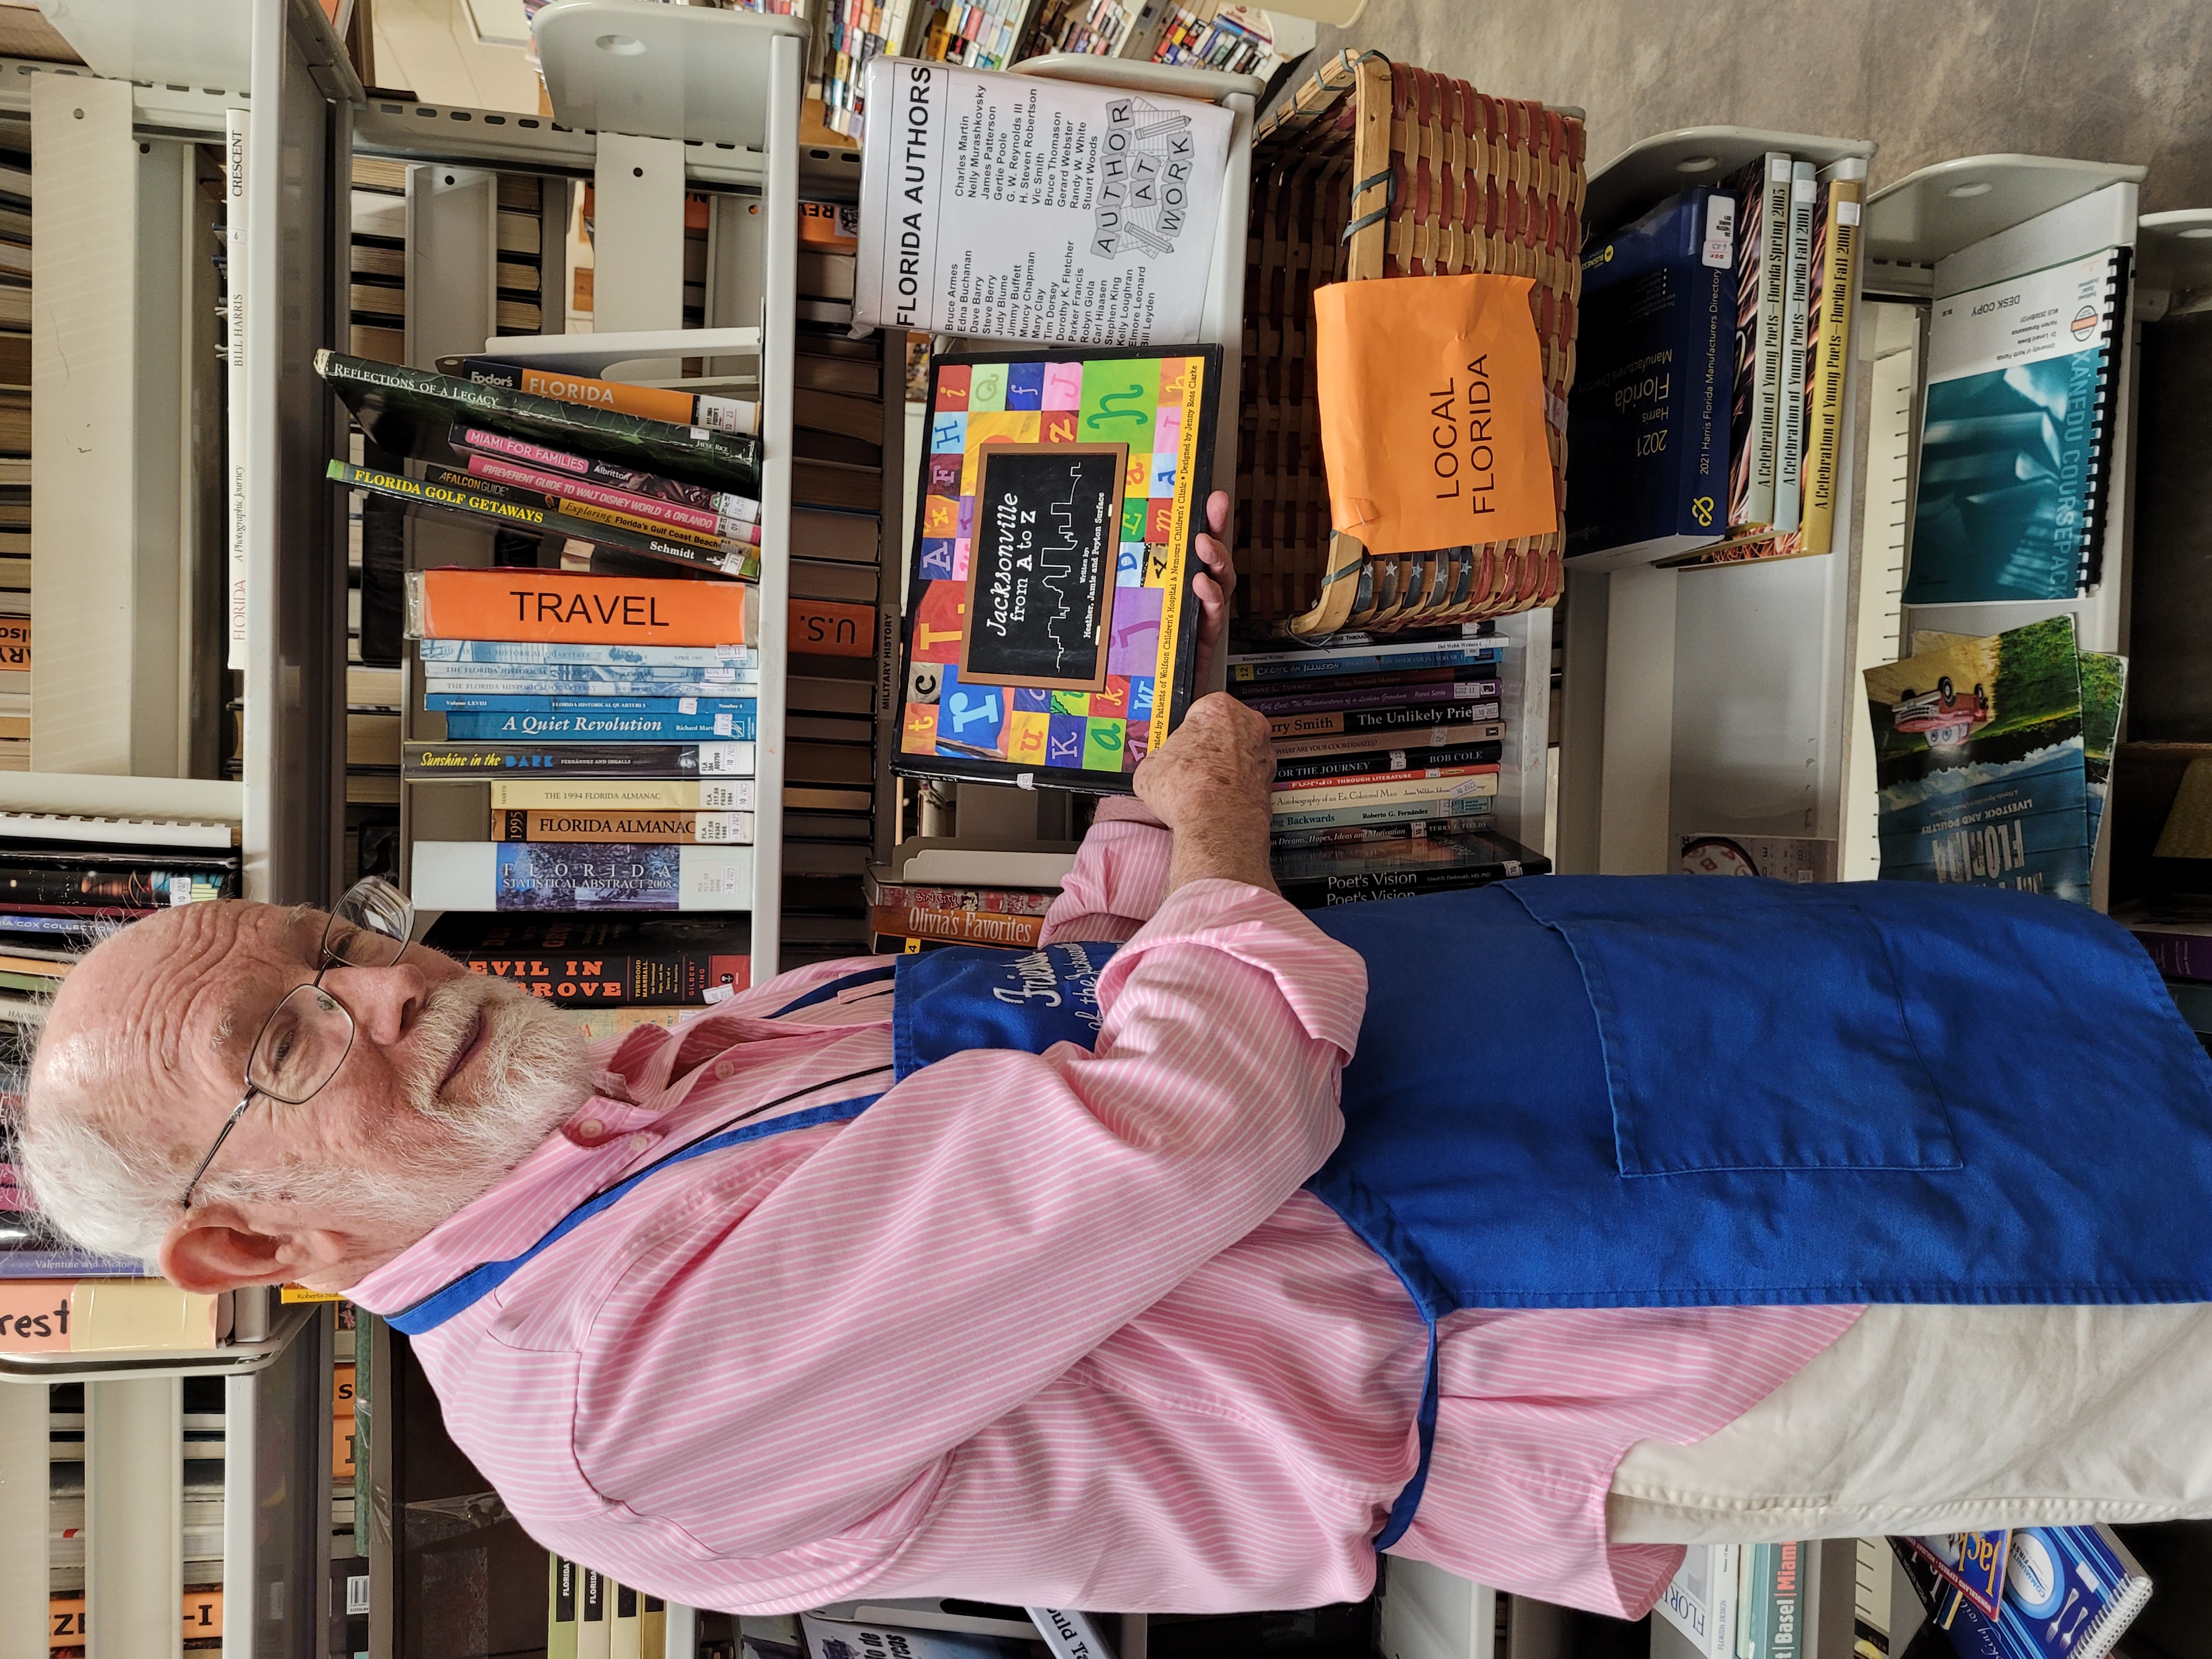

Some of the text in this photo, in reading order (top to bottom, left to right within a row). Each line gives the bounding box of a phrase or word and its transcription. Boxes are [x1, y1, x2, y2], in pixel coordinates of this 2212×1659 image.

[955, 116, 969, 196] Charles Martin
[968, 85, 986, 198] Nelly Murashkovsky
[981, 106, 996, 199] James Patterson
[232, 130, 242, 196] CRESCENT
[994, 133, 1007, 200] Gertie Poole
[1098, 105, 1130, 253] AUTHOR
[1136, 160, 1156, 200] AT
[896, 67, 930, 327] FLORIDA AUTHORS
[1164, 138, 1189, 231] WORK
[1771, 189, 1785, 216] 2003
[1769, 221, 1786, 261] Spring
[945, 264, 958, 330] Bruce Armes
[957, 251, 972, 332] Edna Buchanan
[970, 277, 984, 333] Dave Barry
[982, 275, 997, 334] Steve Berry
[995, 275, 1008, 336] Judy Blume
[1007, 265, 1021, 336] Jimmy Buffett
[1019, 252, 1035, 337] Muncy Chapman
[1971, 295, 2020, 317] DESK COPY
[1031, 289, 1046, 338] Mary Clay
[1043, 282, 1059, 340] Tim Dorsey
[234, 295, 243, 366] BILL HARRIS
[334, 363, 499, 407] REFLECTIONS OF A LEGACY
[1189, 365, 1197, 388] Clarke
[1700, 269, 1722, 475] 2021 Harris Florida Manufacturers Directory
[1763, 351, 1779, 386] Young
[471, 371, 613, 403] Fodor's FLORIDA
[1187, 391, 1195, 407] Ross
[1763, 393, 1774, 403] of
[1184, 409, 1194, 431] Jenny
[1184, 432, 1192, 441] by
[1467, 354, 1495, 515] FLORIDA
[471, 432, 584, 470] MIAMI FOR FAMILIES
[1429, 377, 1459, 499] LOCAL
[1759, 407, 1774, 476] Celebration
[593, 464, 629, 480] Albritton
[1181, 443, 1190, 473] Designed
[354, 470, 543, 523] FLORIDA GOLF GETAWAYS
[482, 464, 713, 528] IRREVERENT GUIDE TO WALT DISNEY WORLD & ORLANDO
[1094, 493, 1104, 523] Surface
[1178, 482, 1187, 504] Clinic
[565, 503, 612, 523] Exploring
[615, 517, 648, 530] Florida's
[651, 526, 667, 535] Gulf
[669, 530, 691, 541] Coast
[1174, 506, 1184, 541] Children's
[650, 541, 695, 559] Schmidt
[1092, 526, 1101, 555] Peyton
[986, 493, 1018, 636] Jacksonville
[1010, 511, 1036, 622] from A to Z
[1080, 559, 1088, 583] Written
[1171, 544, 1181, 574] Nemours
[1087, 575, 1096, 601] Jamie
[1167, 584, 1176, 612] Hospital
[510, 591, 669, 626] TRAVEL
[1084, 603, 1094, 639] Heather,
[800, 616, 856, 644] U.S.
[1163, 615, 1173, 650] Children's
[882, 613, 892, 709] MILITARY HISTORY
[1160, 652, 1170, 679] Wolfson
[1156, 691, 1166, 719] Patients
[1358, 708, 1472, 725] The Unlikely Prie
[501, 716, 662, 734] A Quiet Revolution
[1295, 717, 1333, 730] Smith
[420, 752, 554, 767] Sunshine in the DARK
[1430, 752, 1482, 763] BOB COLE
[510, 812, 522, 838] 1995
[540, 819, 695, 833] FLORIDA ALMANAC
[503, 863, 672, 878] FLORIDA
[503, 878, 673, 889] STATISTICAL ABSTRACT 2008
[1328, 872, 1417, 889] Poet's Vision
[909, 907, 1032, 943] Olivia's Favorites
[469, 961, 602, 976] EVIL IN
[2013, 1542, 2029, 1562] FIRST
[1775, 1599, 1795, 1644] Basel
